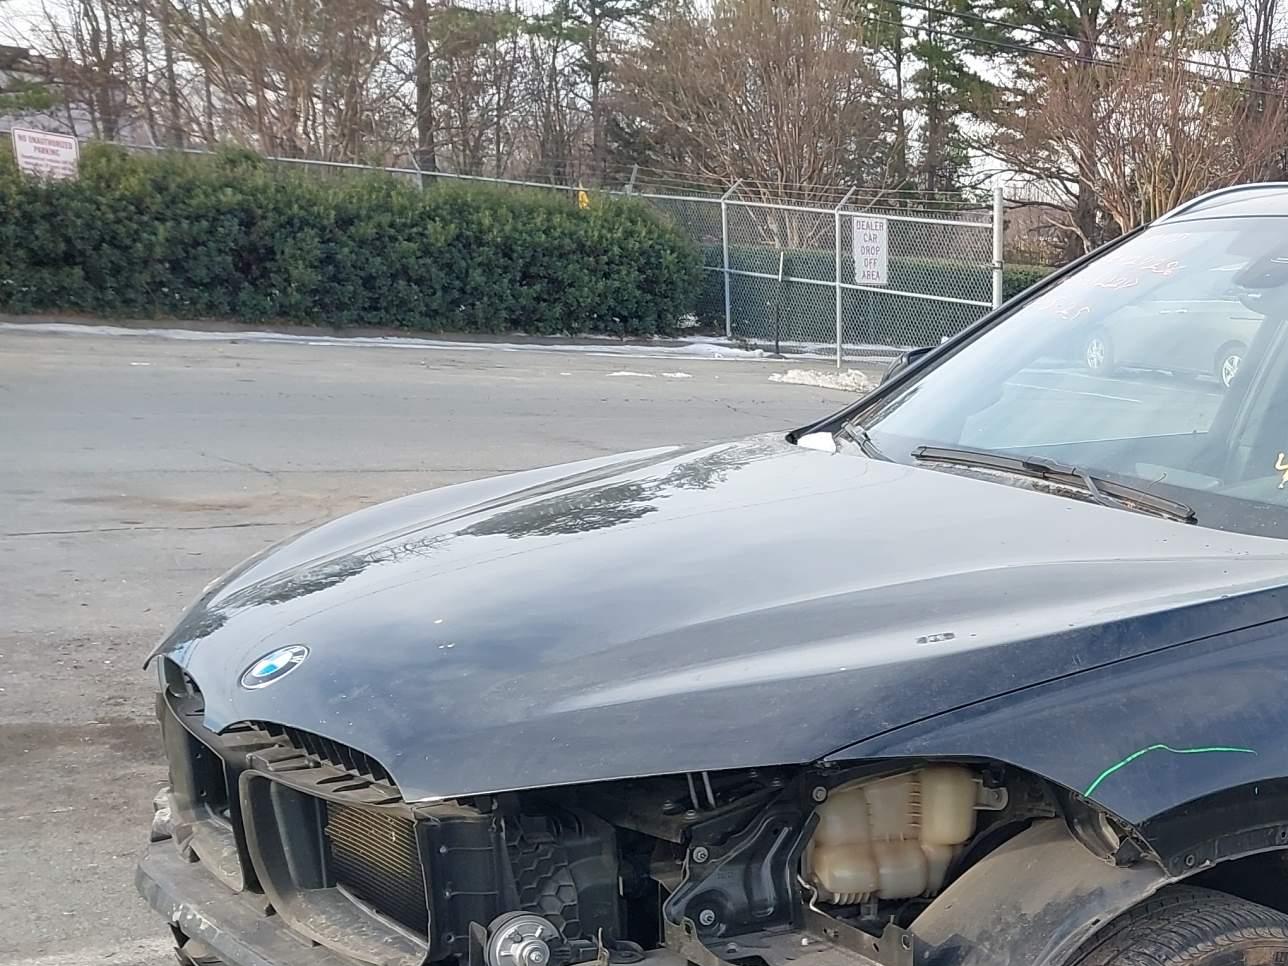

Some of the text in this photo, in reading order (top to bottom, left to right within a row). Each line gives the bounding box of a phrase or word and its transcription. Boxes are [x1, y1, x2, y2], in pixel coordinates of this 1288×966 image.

[856, 220, 884, 231] DEALER
[863, 232, 878, 243] CAR
[860, 245, 881, 256] DROP
[863, 257, 878, 269] OFF
[862, 270, 881, 281] AREA
